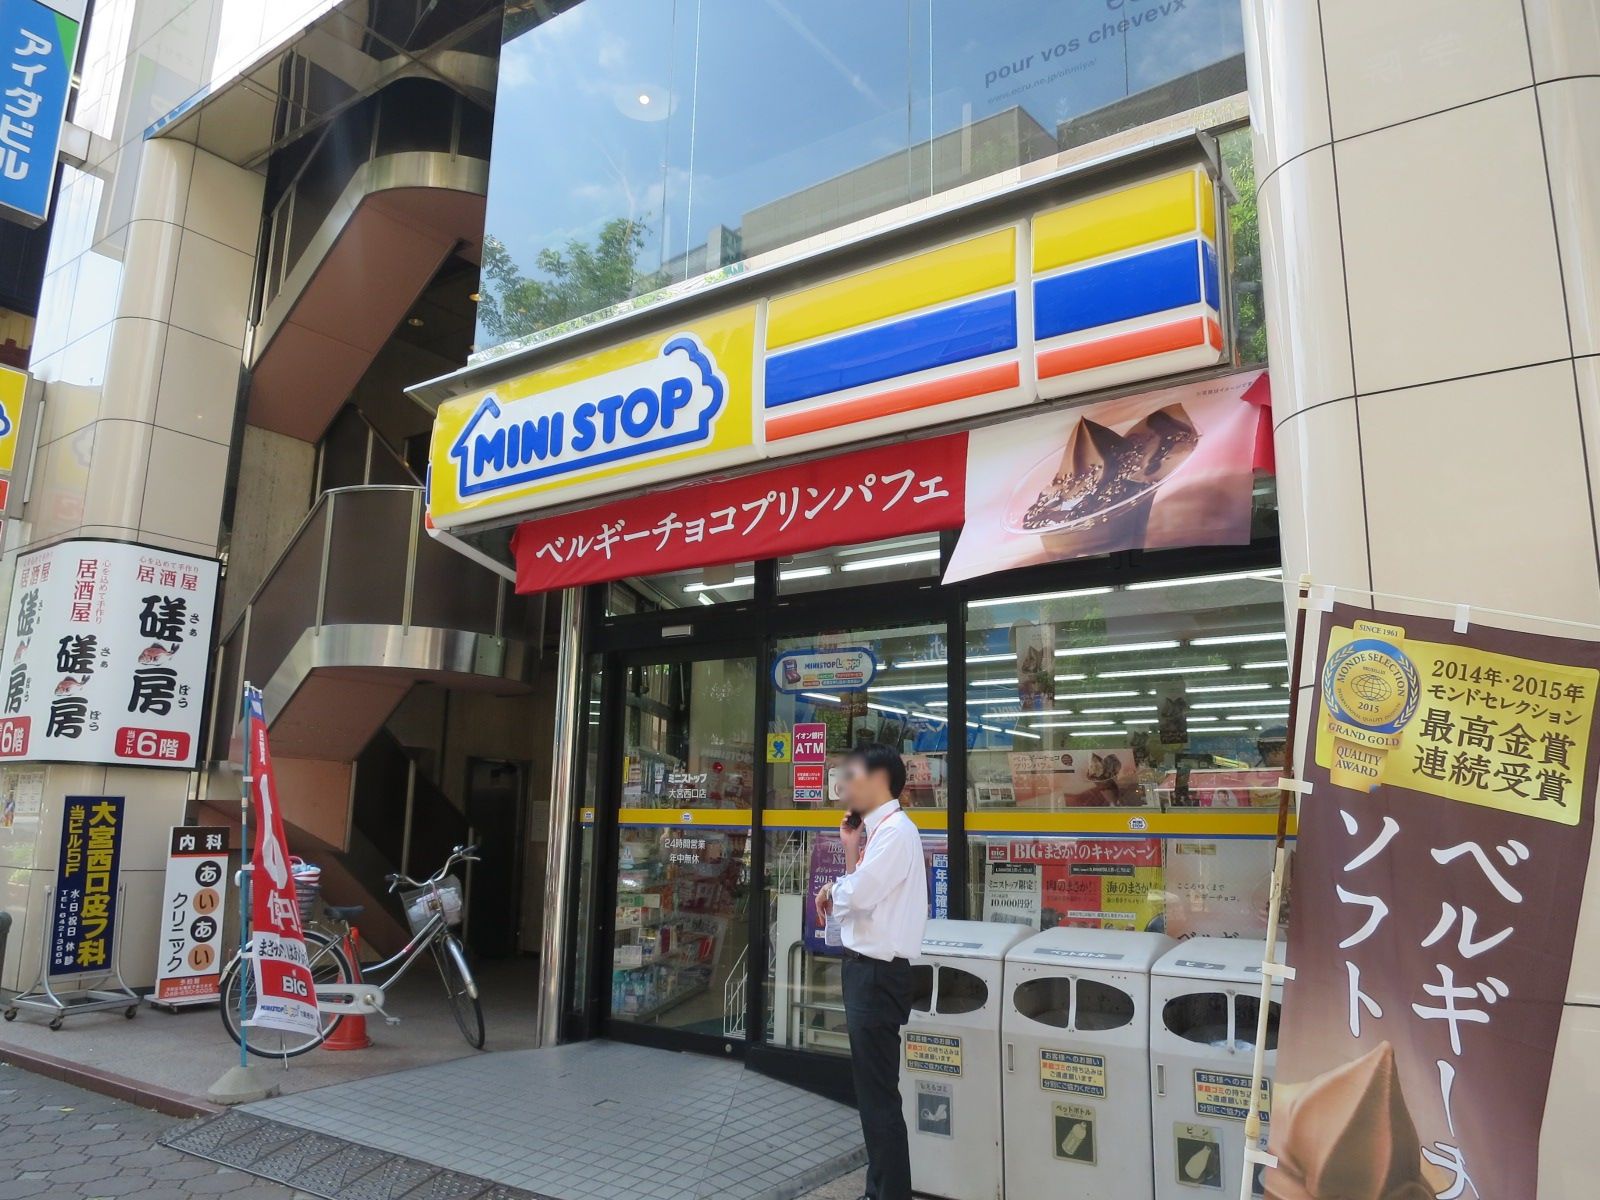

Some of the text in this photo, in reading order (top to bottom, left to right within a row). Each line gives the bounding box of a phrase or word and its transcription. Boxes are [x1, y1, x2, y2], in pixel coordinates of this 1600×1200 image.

[984, 54, 1034, 89] pour
[1041, 35, 1080, 62] vos
[0, 28, 52, 181] アイダビル
[535, 469, 949, 564] ベルギーチョコプリンパフェ
[70, 559, 98, 622] 居酒屋
[137, 565, 199, 592] 居酒屋
[1359, 624, 1398, 637] SINCE 1961
[1337, 652, 1405, 697] MONDE SELECTION
[1357, 702, 1380, 714] 2015
[1427, 684, 1583, 726] モンドセレクション
[795, 731, 824, 740] イオン銀行
[1328, 722, 1400, 747] GRAND GOLD
[1419, 707, 1576, 771] 最高金賞
[795, 742, 824, 754] ATM
[1336, 746, 1382, 766] QUALITY
[668, 773, 708, 783] ミニストップ
[1335, 760, 1378, 778] AWARD
[1412, 744, 1573, 808] 連続受賞
[668, 788, 707, 799] 大宮西口店
[795, 790, 822, 798] SECOM
[65, 804, 85, 878] 当ビル5F
[179, 834, 222, 851] 内科
[664, 838, 706, 850] 24時間営業
[669, 854, 700, 864] 年中無休
[76, 801, 117, 967] 大宮西口皮フ科
[60, 890, 69, 908] TEL
[192, 863, 218, 964] あいあい
[1336, 810, 1400, 1038] ソフト
[167, 892, 188, 973] クリニック
[64, 941, 75, 966] 休診
[1056, 1105, 1092, 1116] ペットボトル
[1186, 1126, 1209, 1136] ビン
